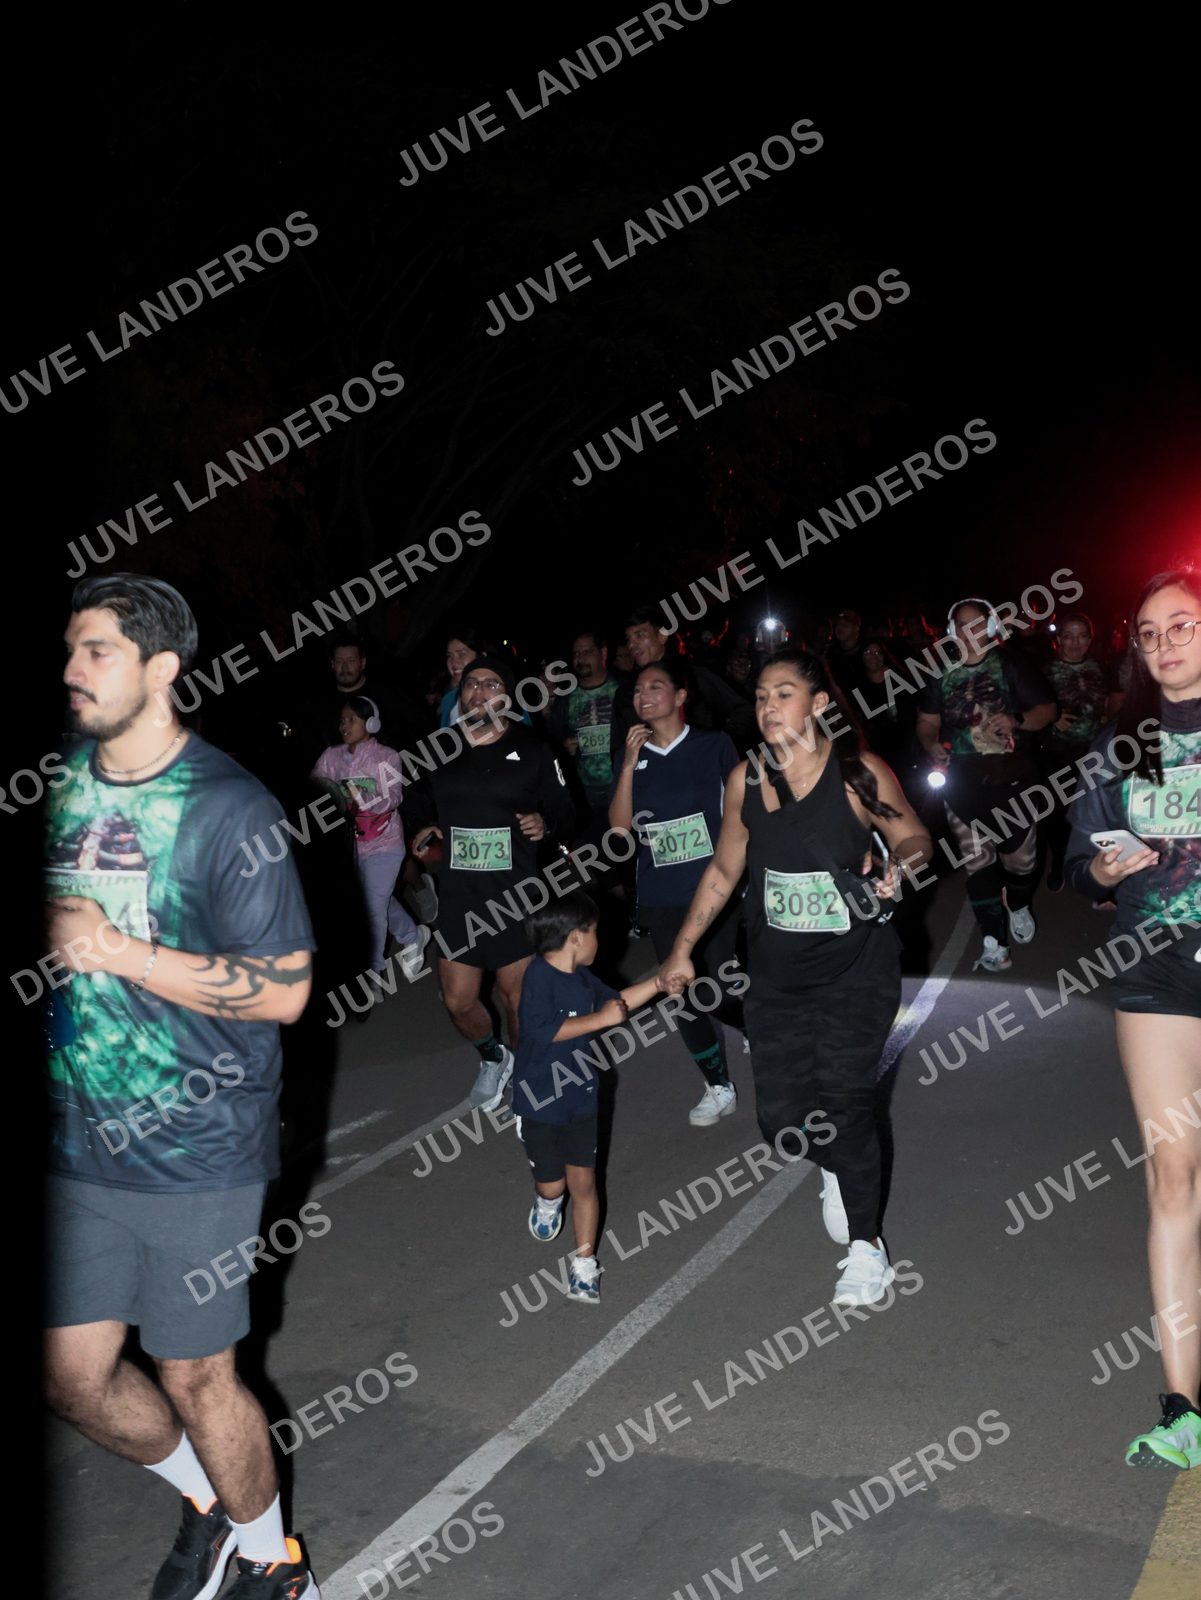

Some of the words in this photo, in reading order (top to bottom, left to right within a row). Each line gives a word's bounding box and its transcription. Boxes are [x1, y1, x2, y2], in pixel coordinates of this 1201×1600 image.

[1143, 788, 1201, 820] 184
[457, 841, 506, 860] 3073
[658, 828, 705, 855] 3072
[772, 890, 840, 916] 3082
